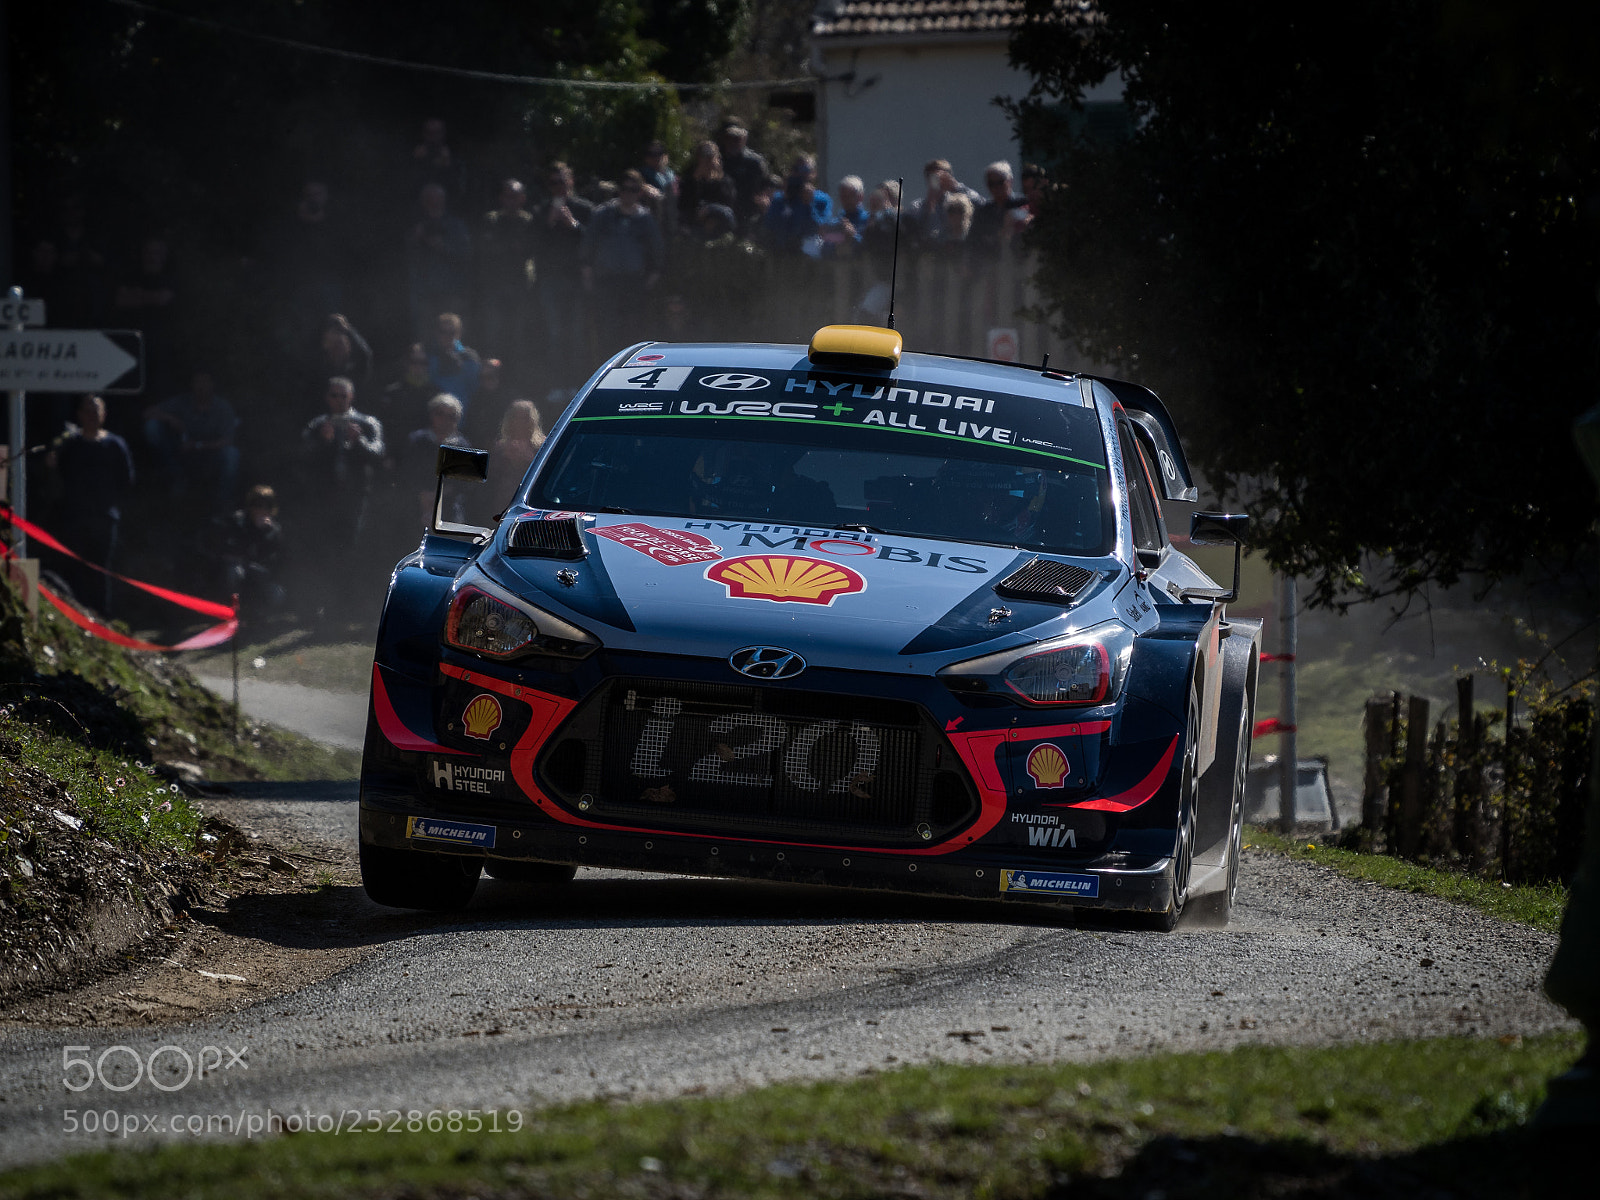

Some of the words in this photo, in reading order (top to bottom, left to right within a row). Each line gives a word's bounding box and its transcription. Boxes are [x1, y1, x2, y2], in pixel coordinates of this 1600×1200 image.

[627, 367, 668, 389] 4
[784, 377, 995, 414] HYUNDAI
[862, 409, 926, 431] ALL
[938, 418, 1012, 444] LIVE
[684, 521, 874, 543] HYUNDAI
[737, 532, 989, 574] MOBIS
[454, 765, 505, 782] HYUNDAI
[455, 781, 491, 794] STEEL
[1011, 813, 1059, 826] HYUNDAI
[427, 825, 487, 842] MICHELIN
[1029, 877, 1092, 891] MICHELIN
